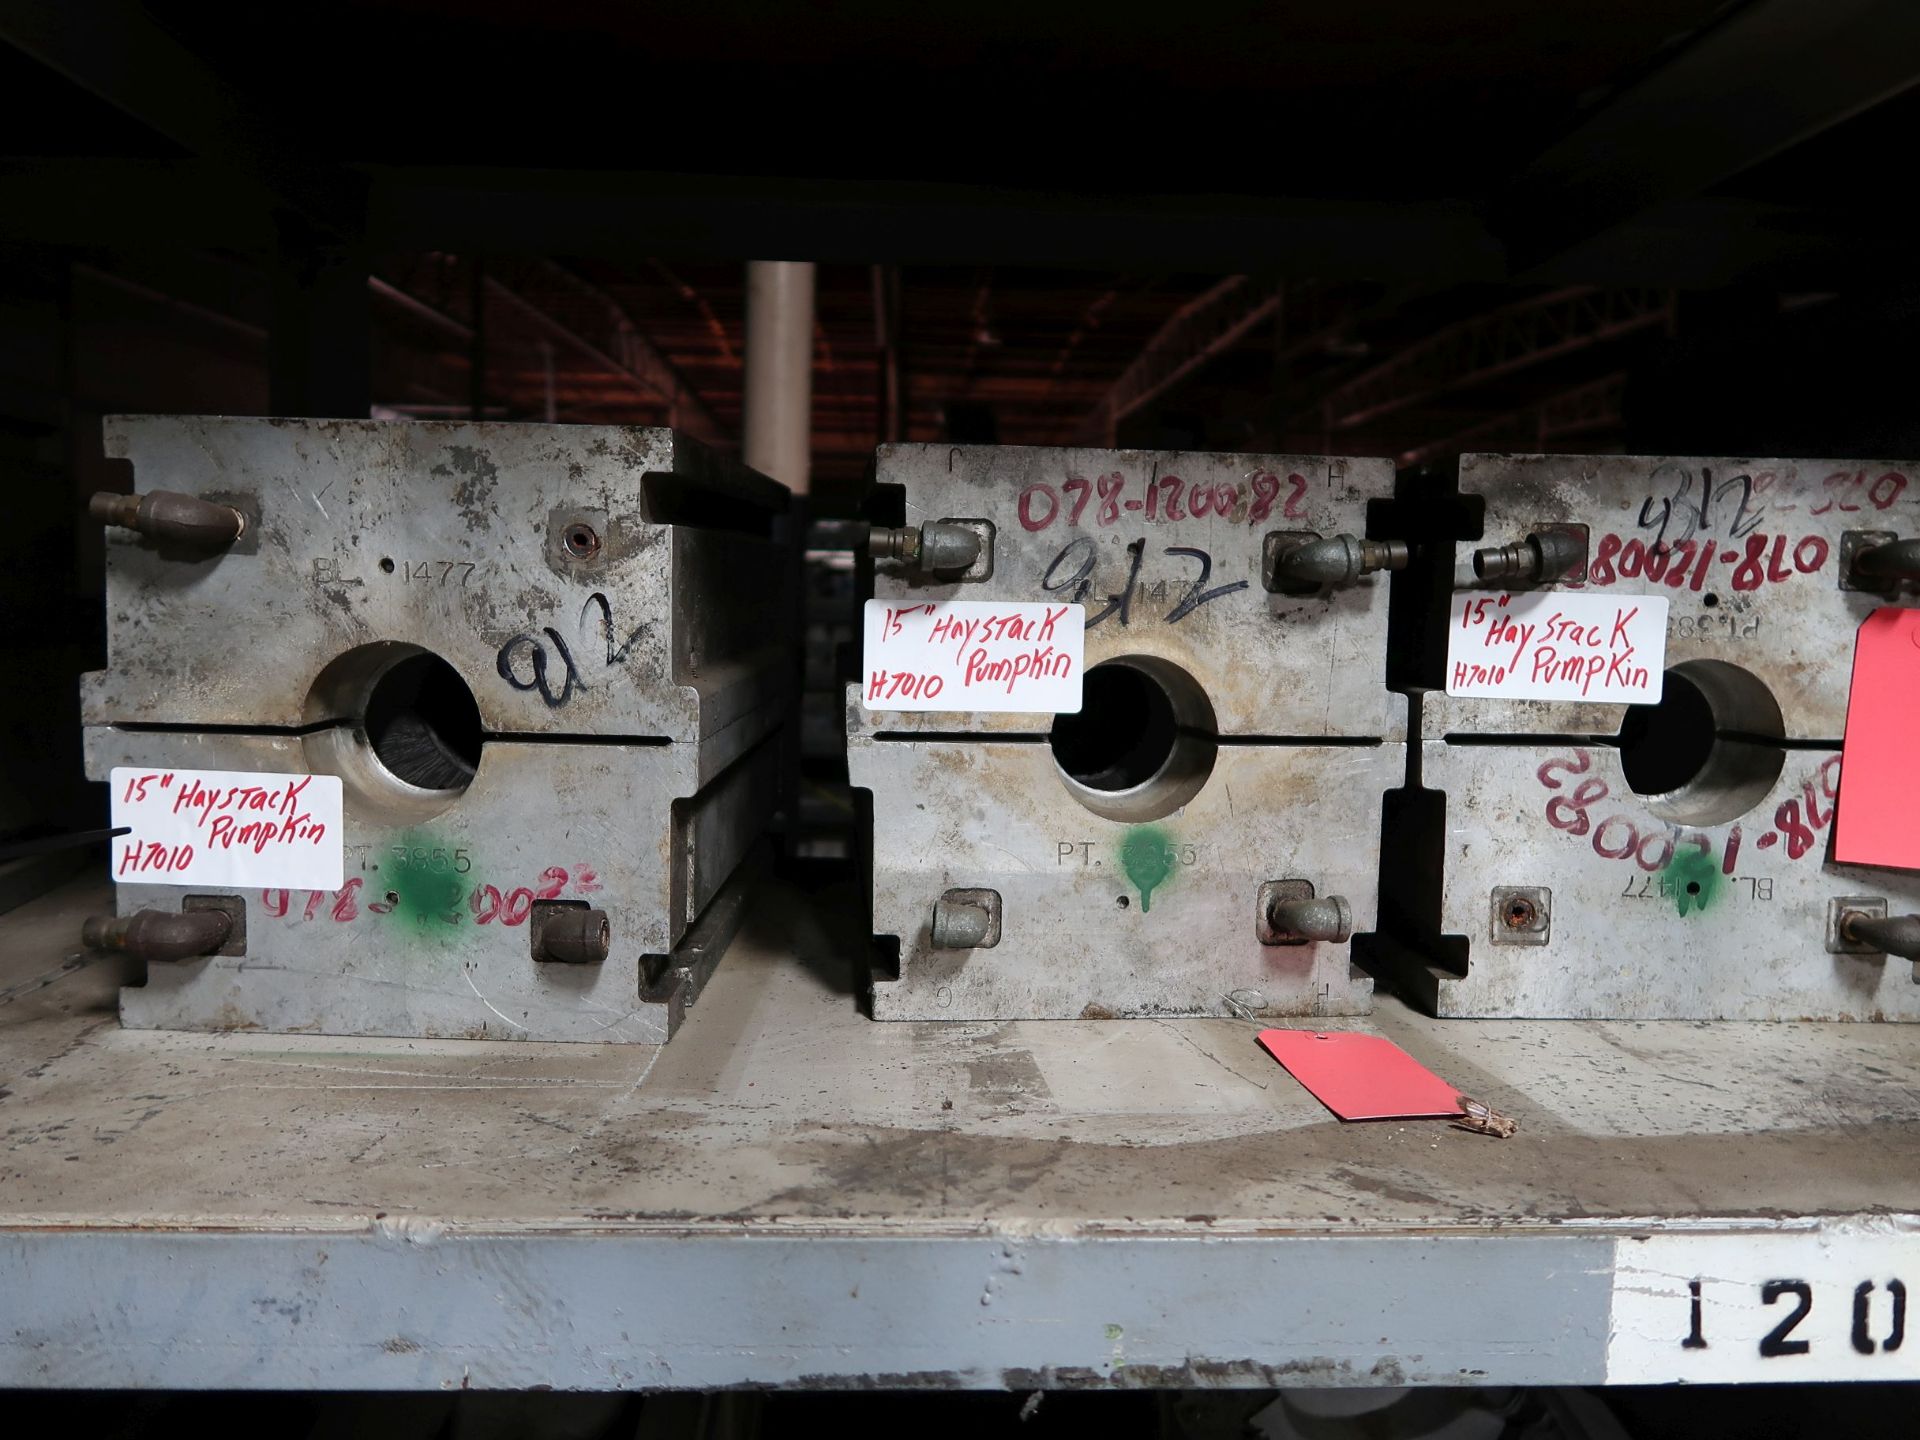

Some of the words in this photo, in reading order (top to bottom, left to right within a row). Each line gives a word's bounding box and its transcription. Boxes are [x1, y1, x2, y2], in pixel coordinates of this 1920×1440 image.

[403, 560, 476, 587] 1477
[867, 670, 944, 701] H7010
[1453, 661, 1506, 690] H7010
[118, 839, 194, 876] H7010
[1057, 841, 1102, 867] PT.
[1682, 1277, 1907, 1358] 120
